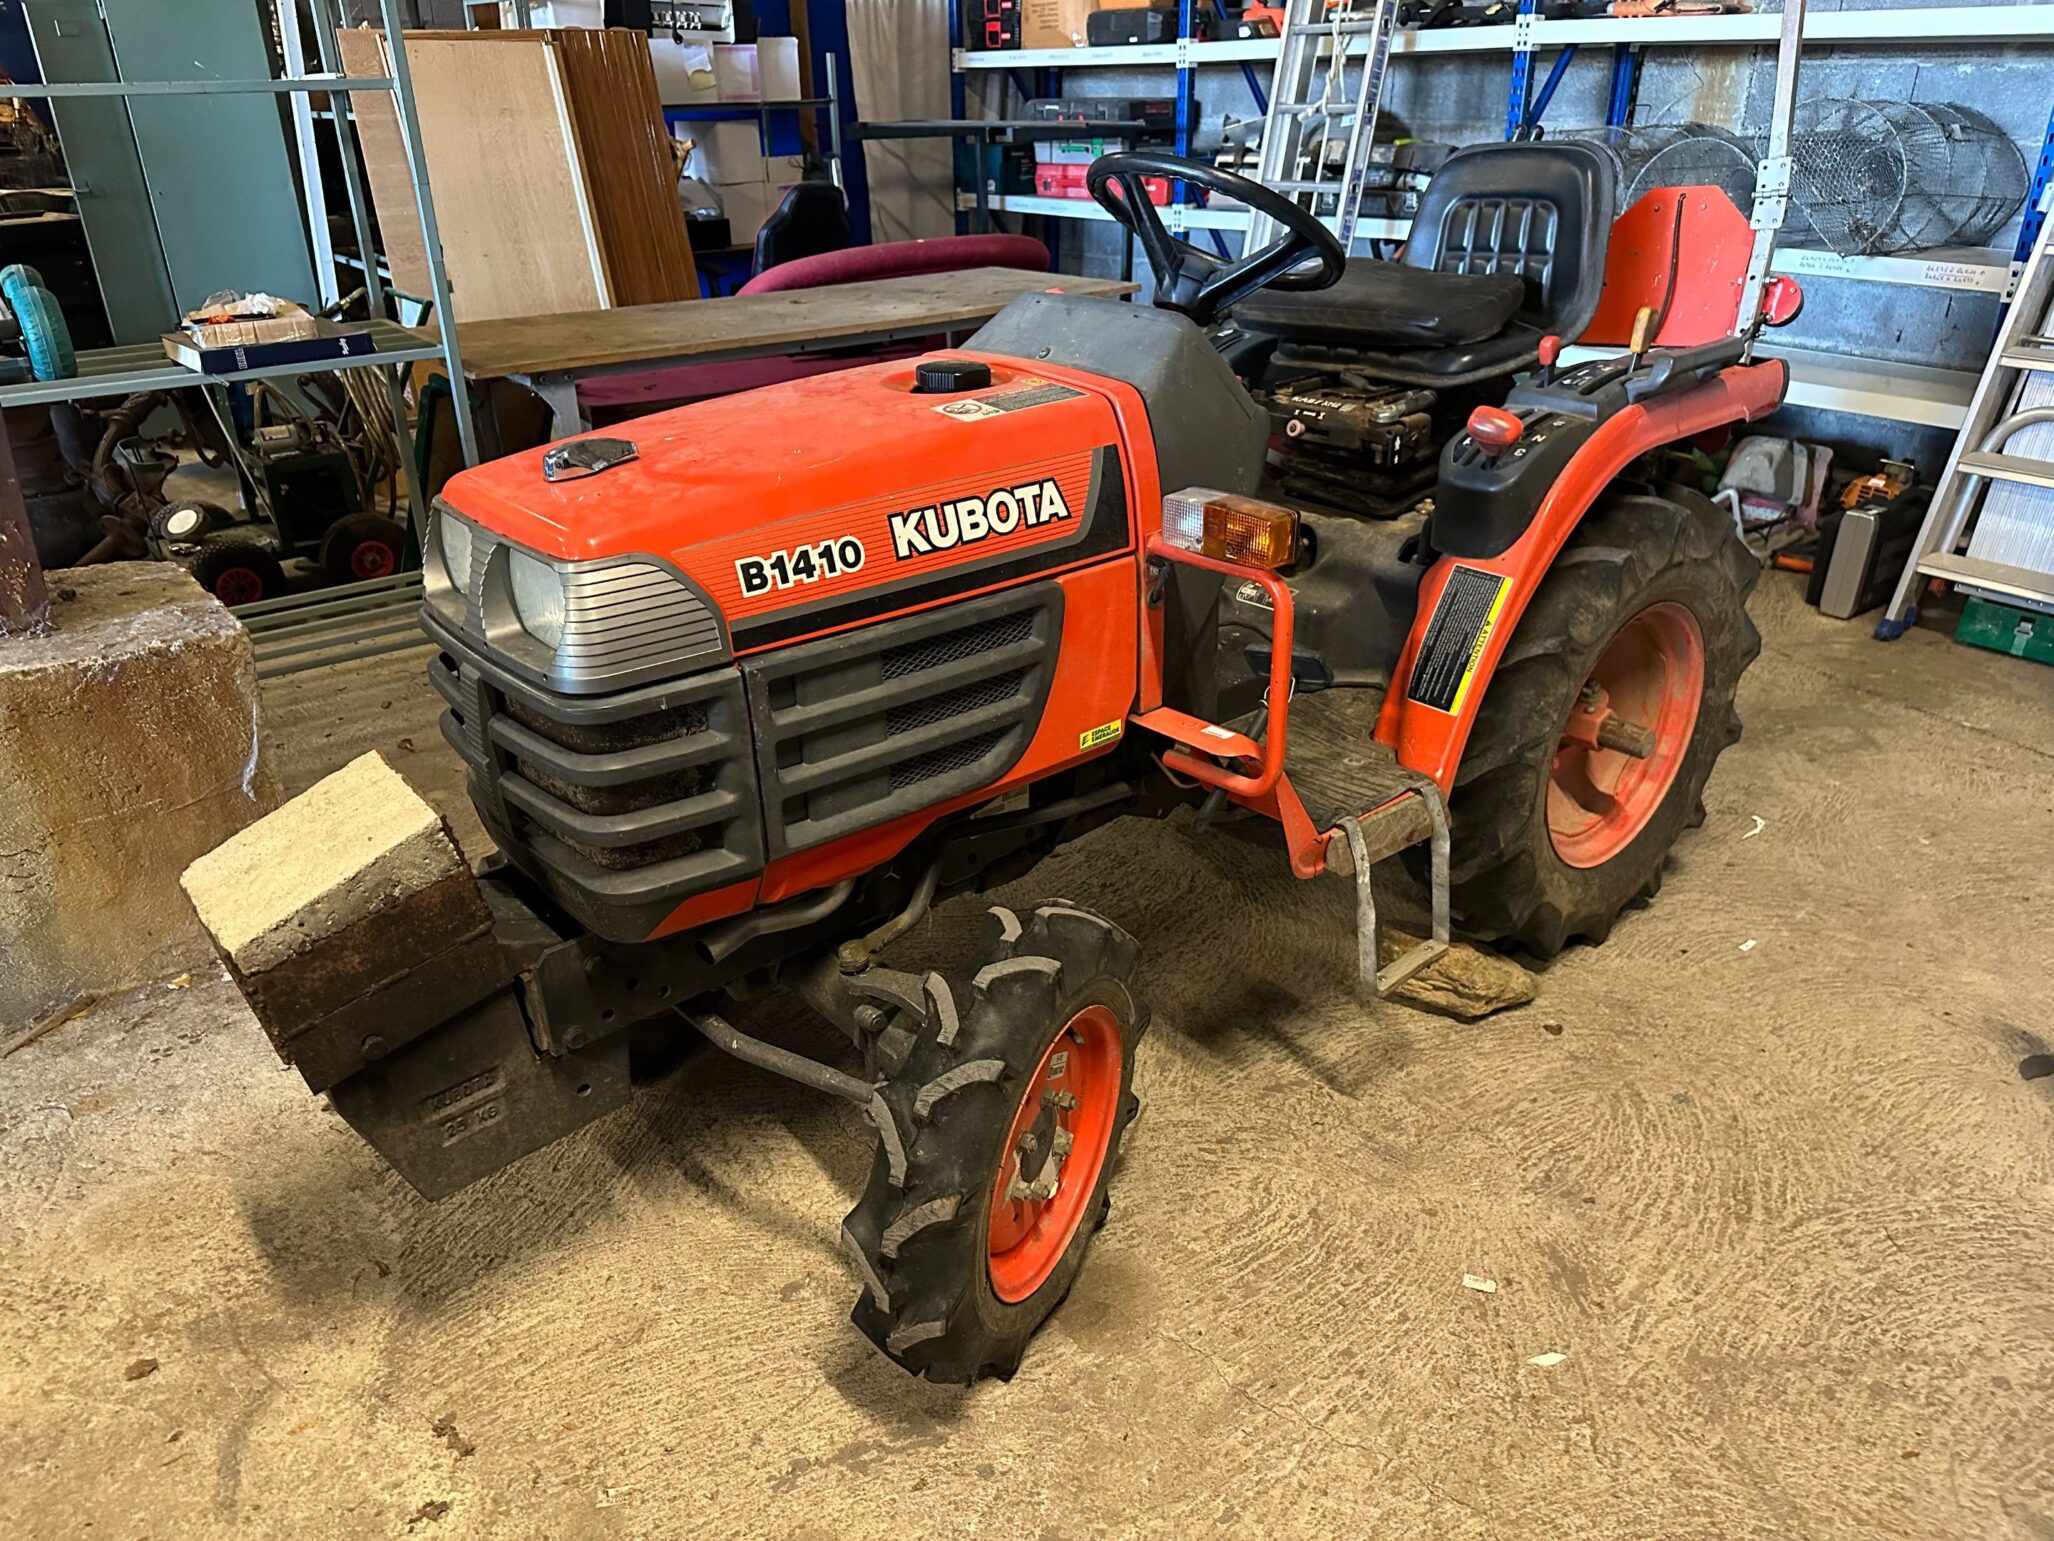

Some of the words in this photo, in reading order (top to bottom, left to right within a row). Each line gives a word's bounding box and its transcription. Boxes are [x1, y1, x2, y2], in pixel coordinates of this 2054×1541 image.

[888, 478, 1072, 561] KUBOTA
[735, 536, 865, 598] B1410
[1466, 629, 1489, 673] ATTENTION
[1092, 724, 1111, 736] ESPACE
[428, 1072, 497, 1112] KUBOTA
[443, 1117, 467, 1138] 25
[474, 1103, 498, 1123] KG
